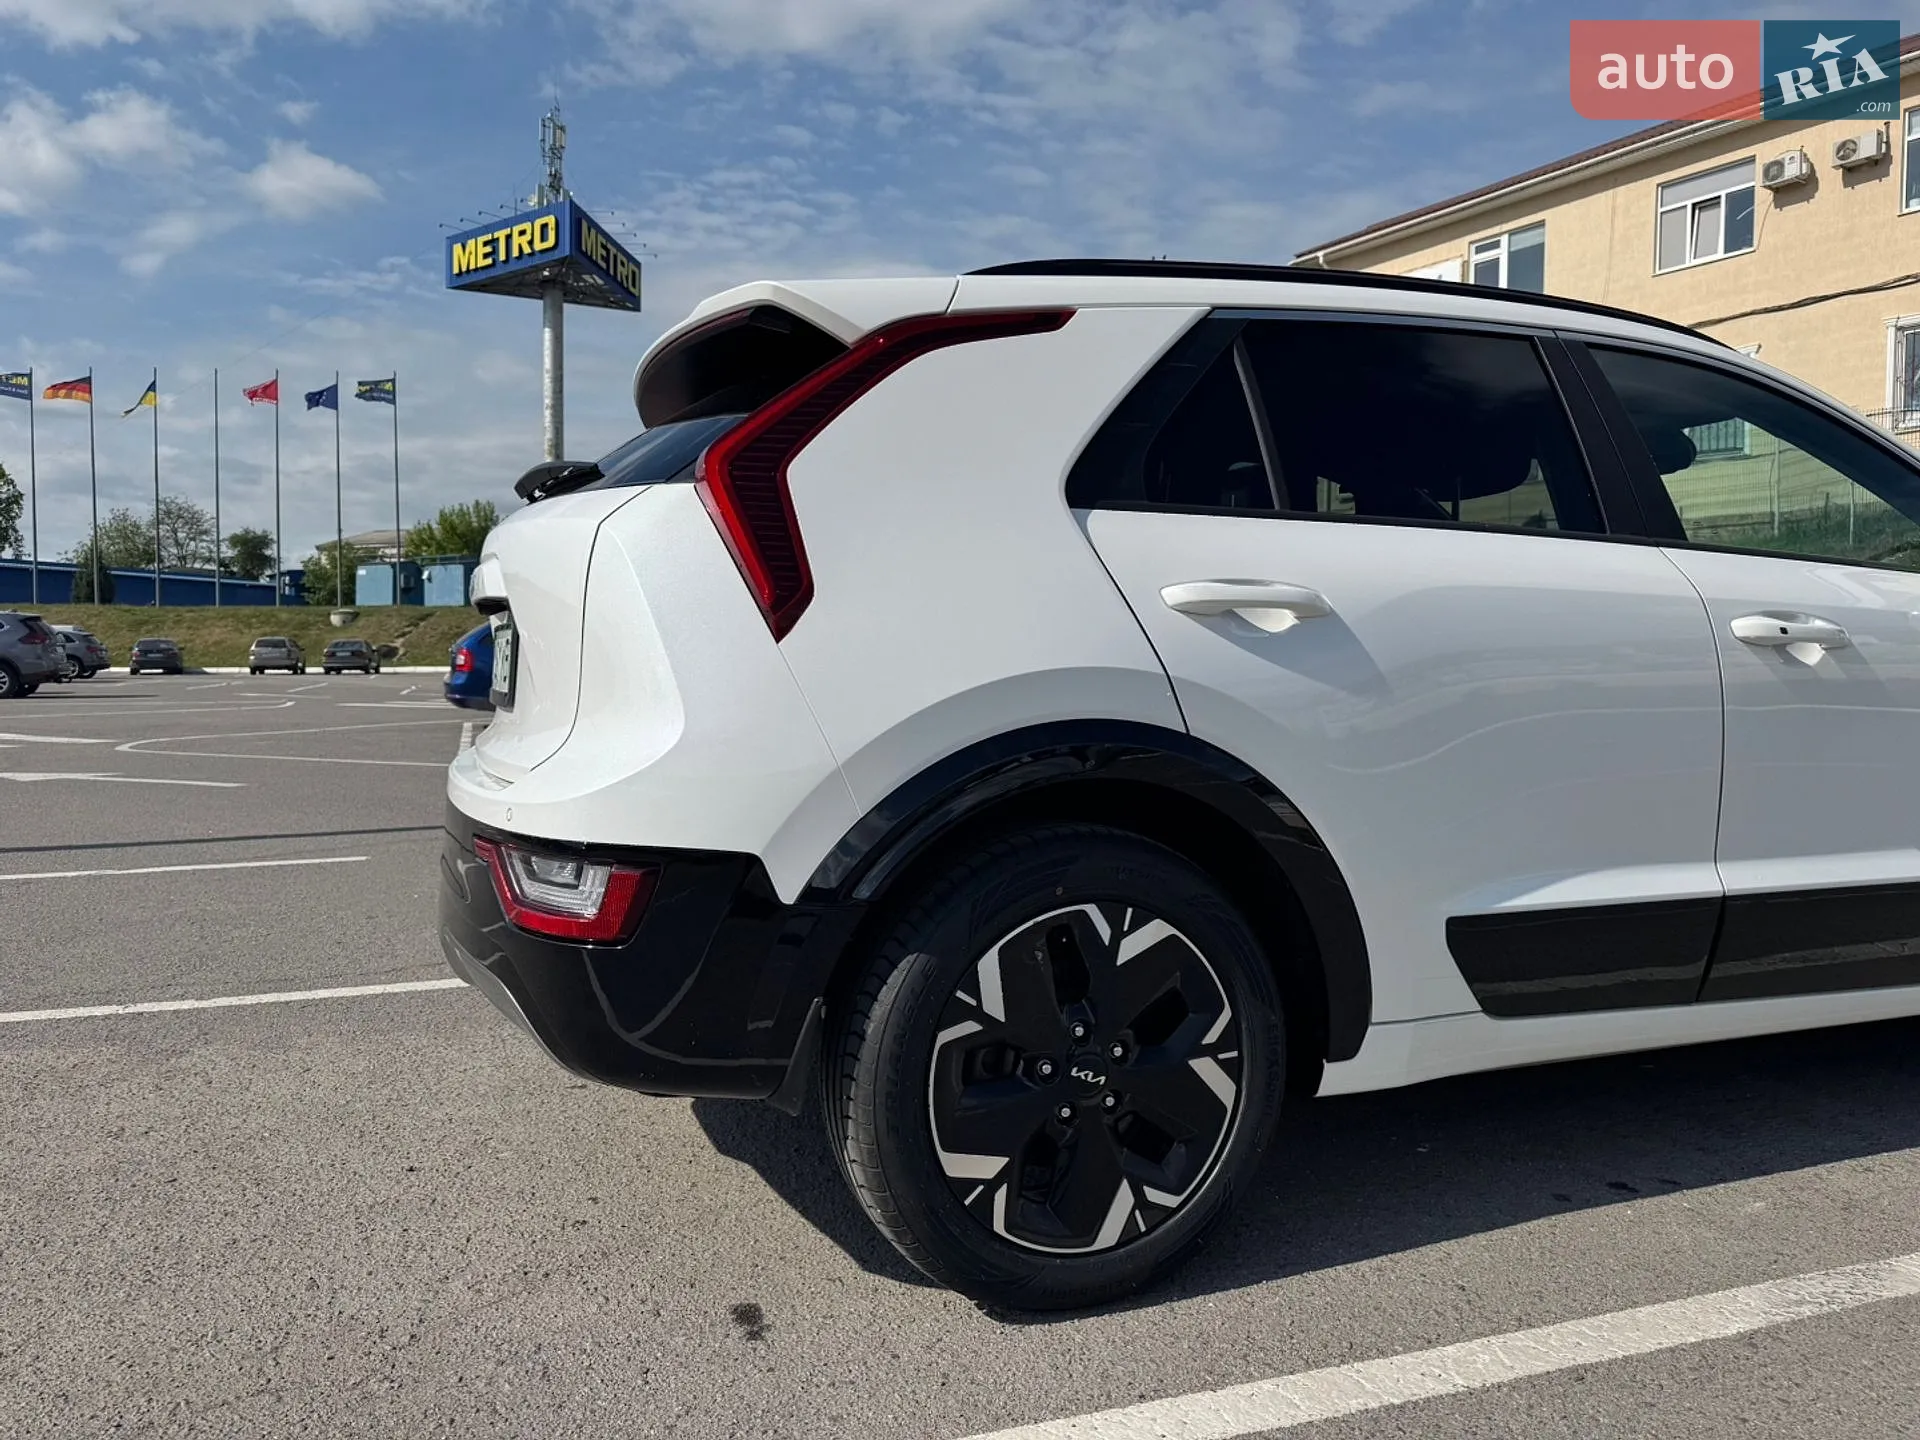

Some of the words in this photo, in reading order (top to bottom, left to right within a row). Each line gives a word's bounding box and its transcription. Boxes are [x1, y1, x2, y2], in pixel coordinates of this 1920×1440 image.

[452, 214, 556, 275] METRO
[581, 218, 640, 297] METRO
[1071, 1066, 1106, 1085] KIA
